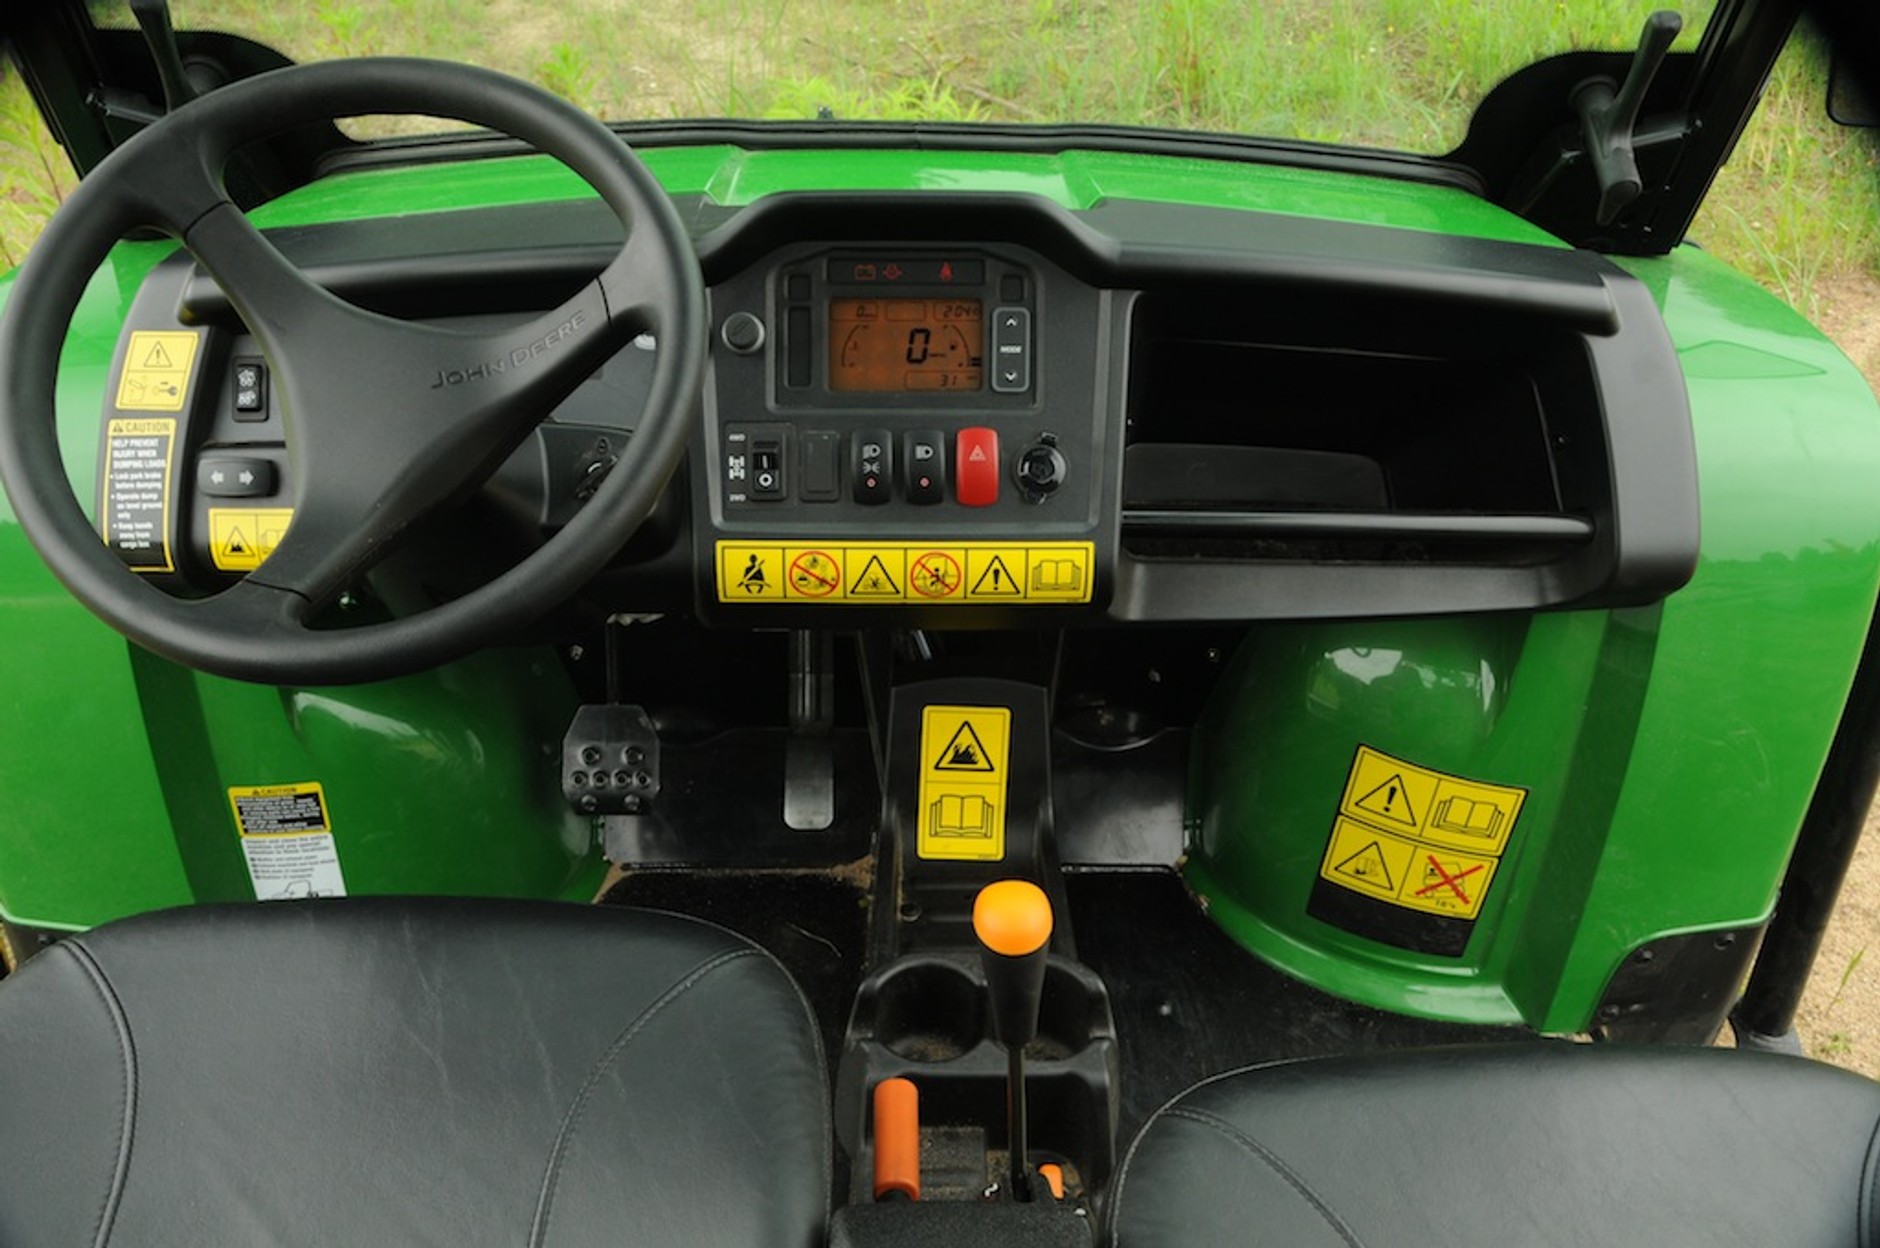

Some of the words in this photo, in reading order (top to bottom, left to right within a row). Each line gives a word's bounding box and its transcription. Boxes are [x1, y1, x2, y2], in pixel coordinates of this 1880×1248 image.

[431, 359, 506, 389] JOHN
[510, 310, 586, 368] DEERE
[906, 328, 931, 365] 0
[1000, 345, 1023, 354] MODE
[125, 422, 170, 433] CAUTION
[129, 438, 159, 448] PREVENT
[113, 449, 135, 458] INJURY
[138, 449, 157, 458] WHEN
[114, 460, 143, 469] DUMPING
[144, 459, 167, 468] LOADS
[136, 481, 163, 490] dumping
